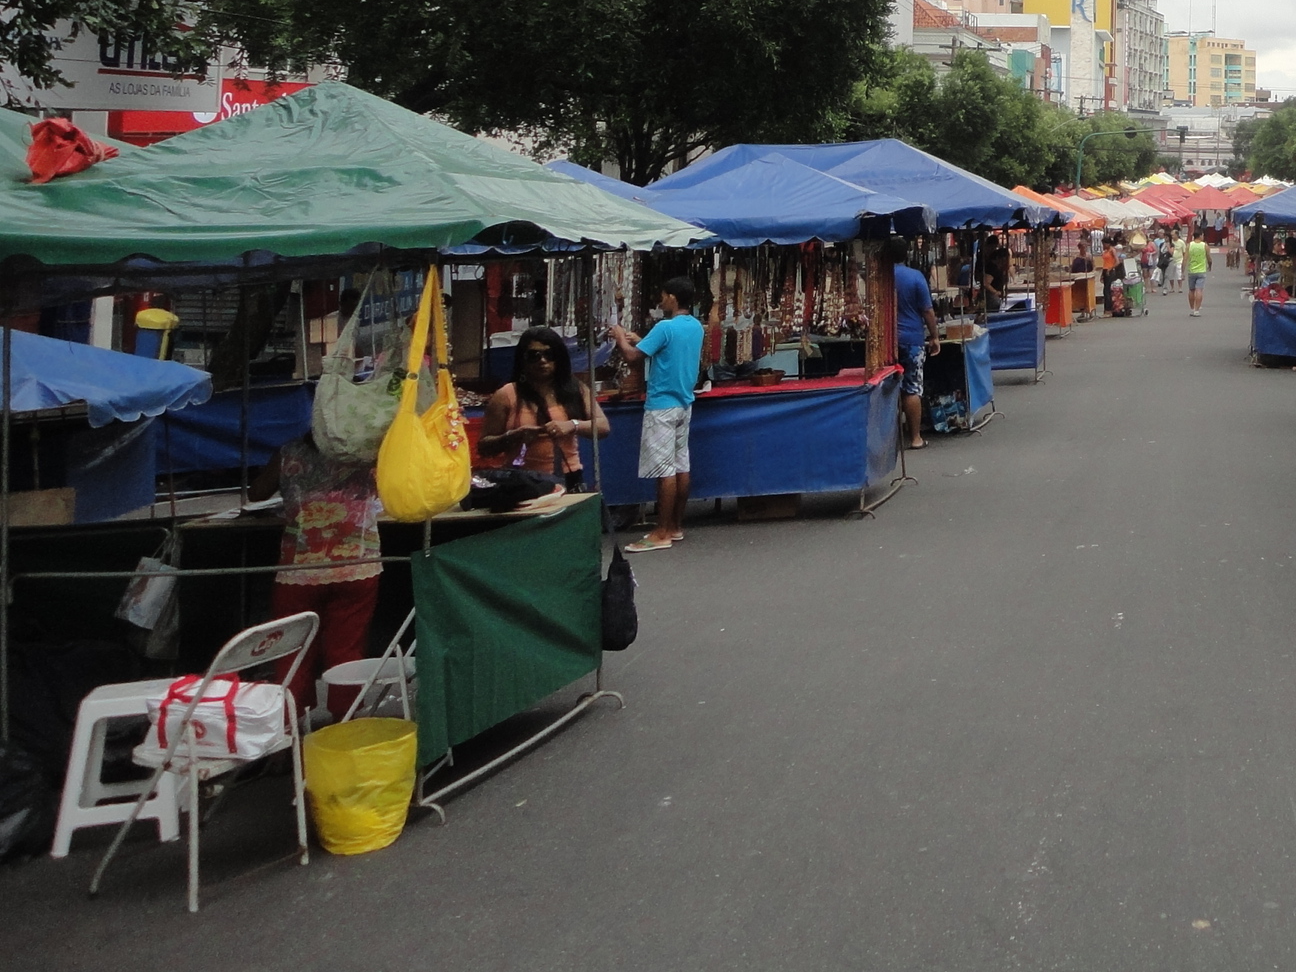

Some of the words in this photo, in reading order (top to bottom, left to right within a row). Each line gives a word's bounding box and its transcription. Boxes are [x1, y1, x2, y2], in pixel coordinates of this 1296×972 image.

[109, 82, 121, 94] AS
[122, 83, 149, 96] LOJAS
[150, 84, 161, 96] DA
